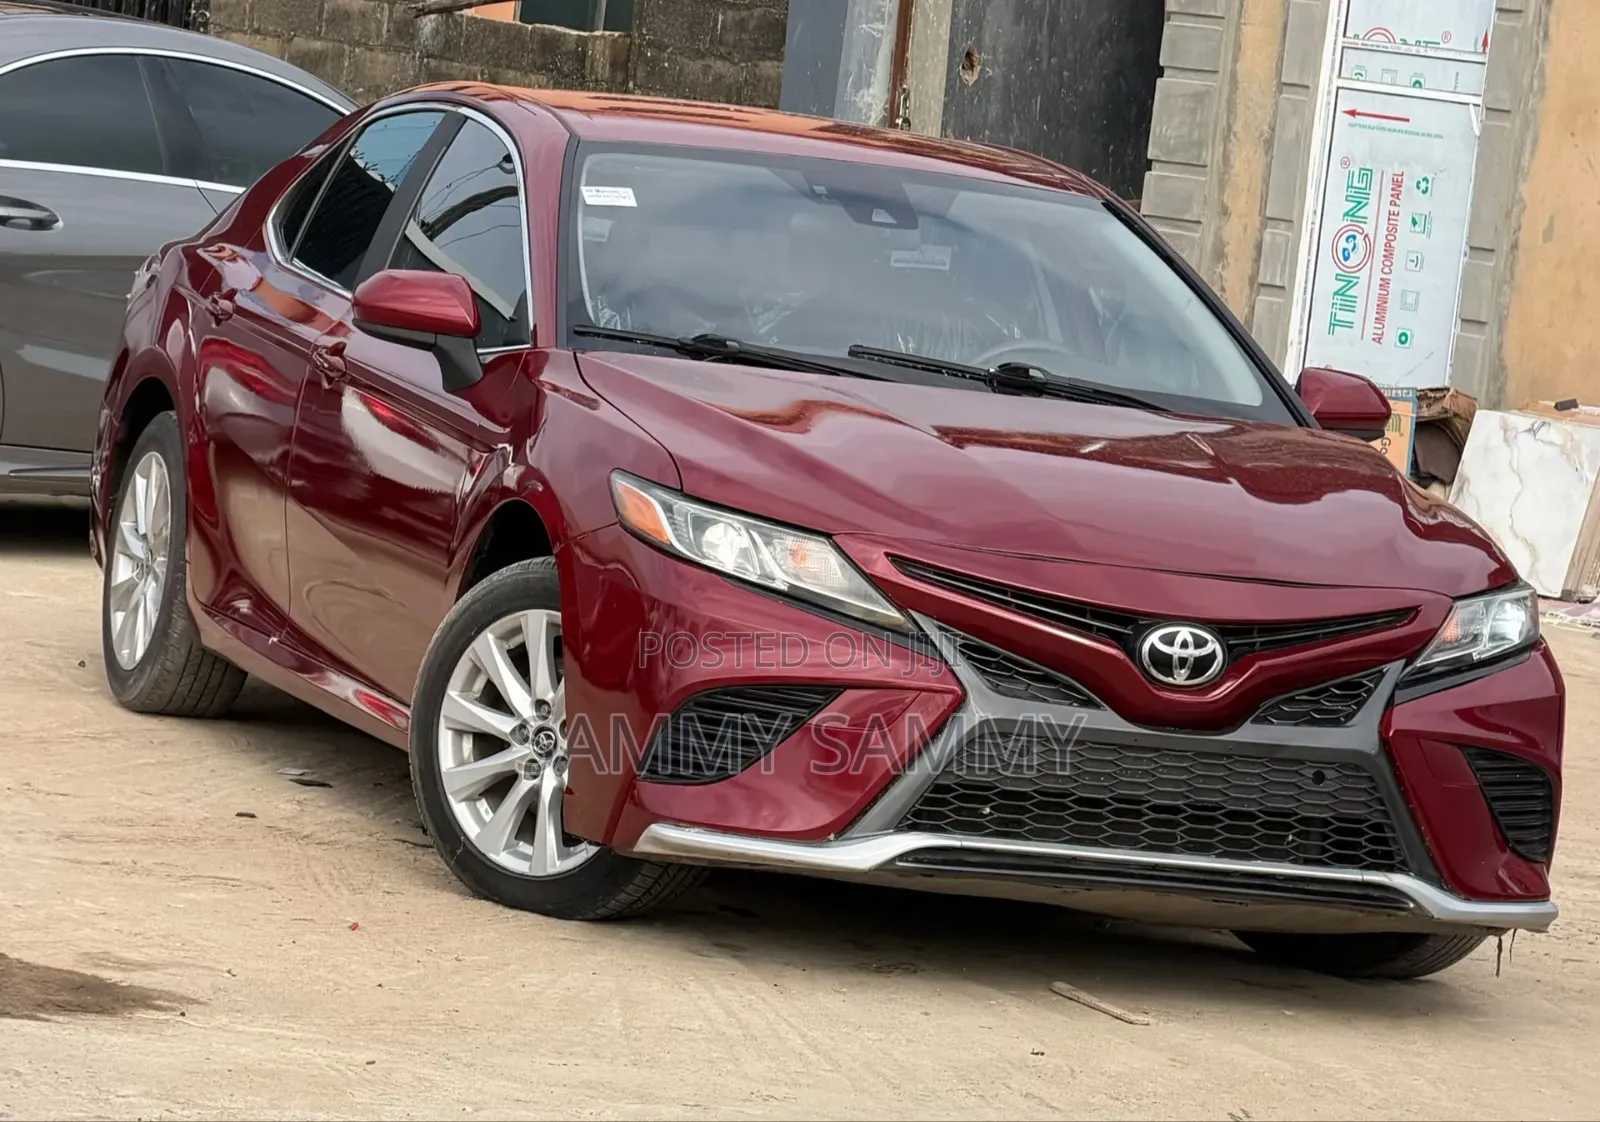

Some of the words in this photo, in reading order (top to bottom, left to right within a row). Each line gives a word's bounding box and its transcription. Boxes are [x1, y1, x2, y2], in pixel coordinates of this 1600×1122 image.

[1389, 171, 1404, 208] PANEL
[1381, 209, 1400, 275] COMPOSITE
[1371, 276, 1392, 345] ALUMINIUM
